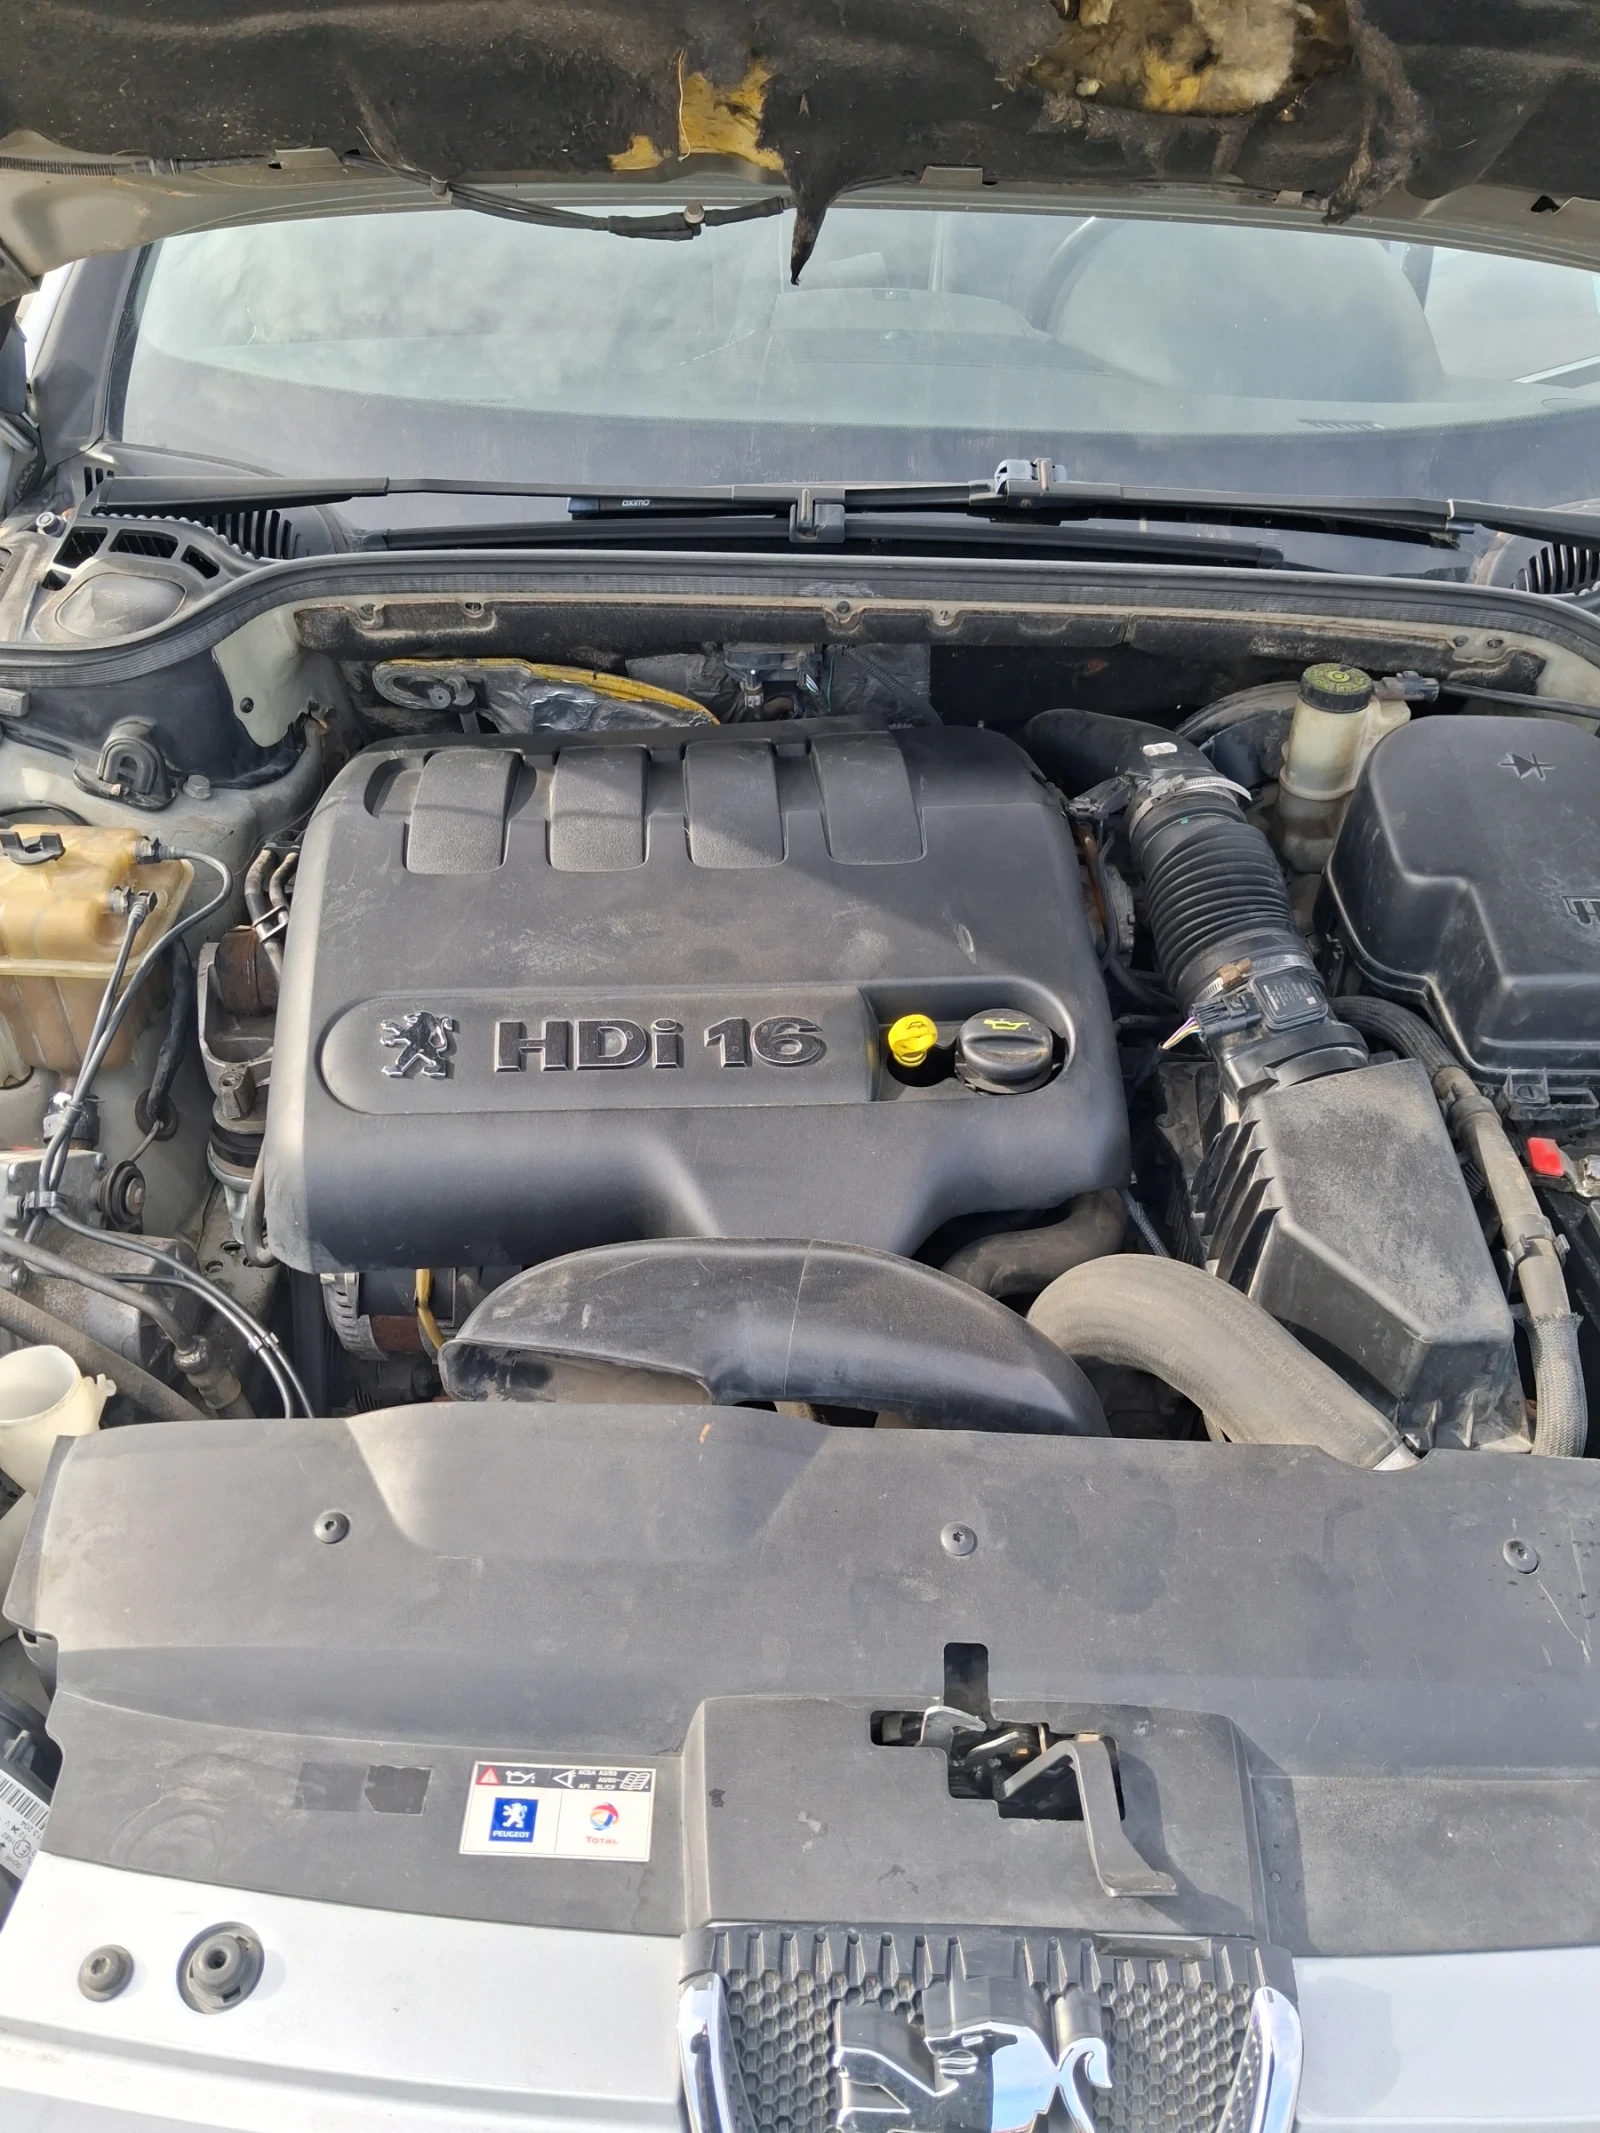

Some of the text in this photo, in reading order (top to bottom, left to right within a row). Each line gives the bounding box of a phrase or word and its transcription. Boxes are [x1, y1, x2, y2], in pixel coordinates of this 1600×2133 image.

[494, 1016, 823, 1072] HDi 16
[492, 1830, 530, 1838] PEUGEOT
[585, 1835, 619, 1844] TOTAL
